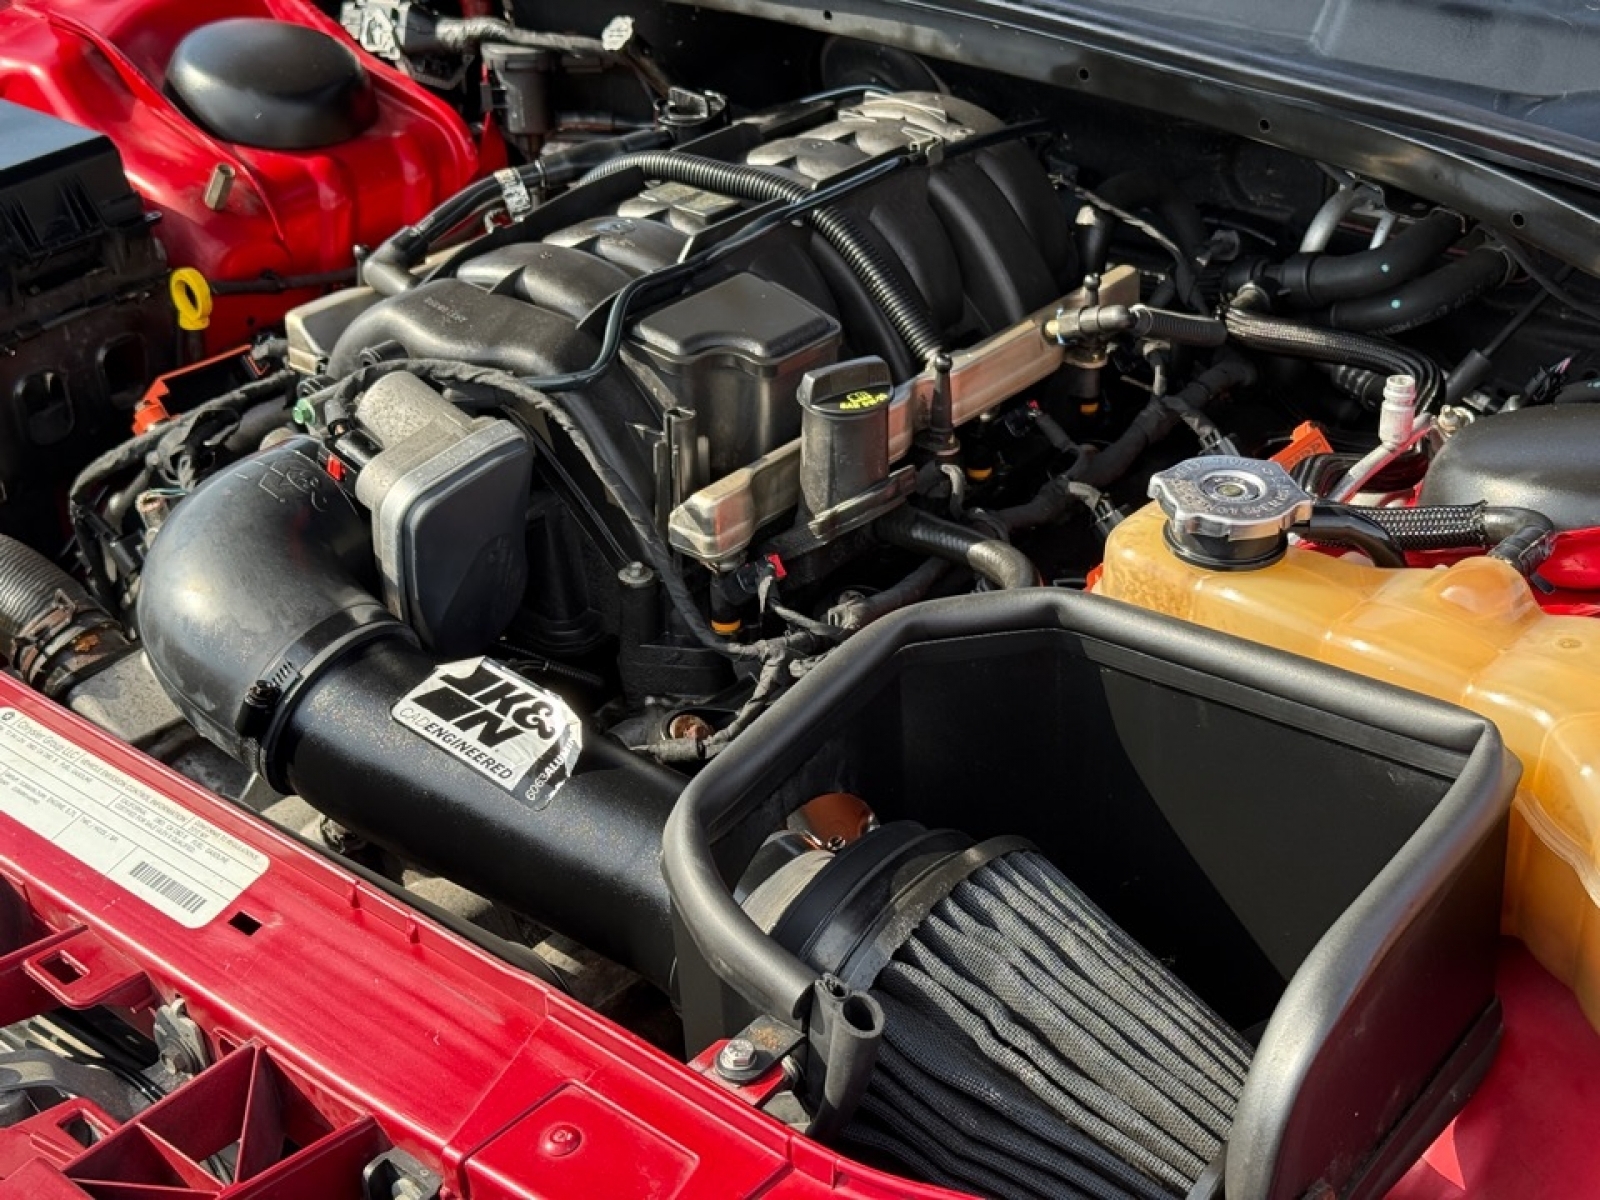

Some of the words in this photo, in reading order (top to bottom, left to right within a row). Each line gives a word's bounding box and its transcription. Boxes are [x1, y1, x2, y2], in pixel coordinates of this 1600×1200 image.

[43, 735, 66, 751] Group
[62, 746, 79, 759] LLC
[400, 706, 513, 779] CADENGINEERED
